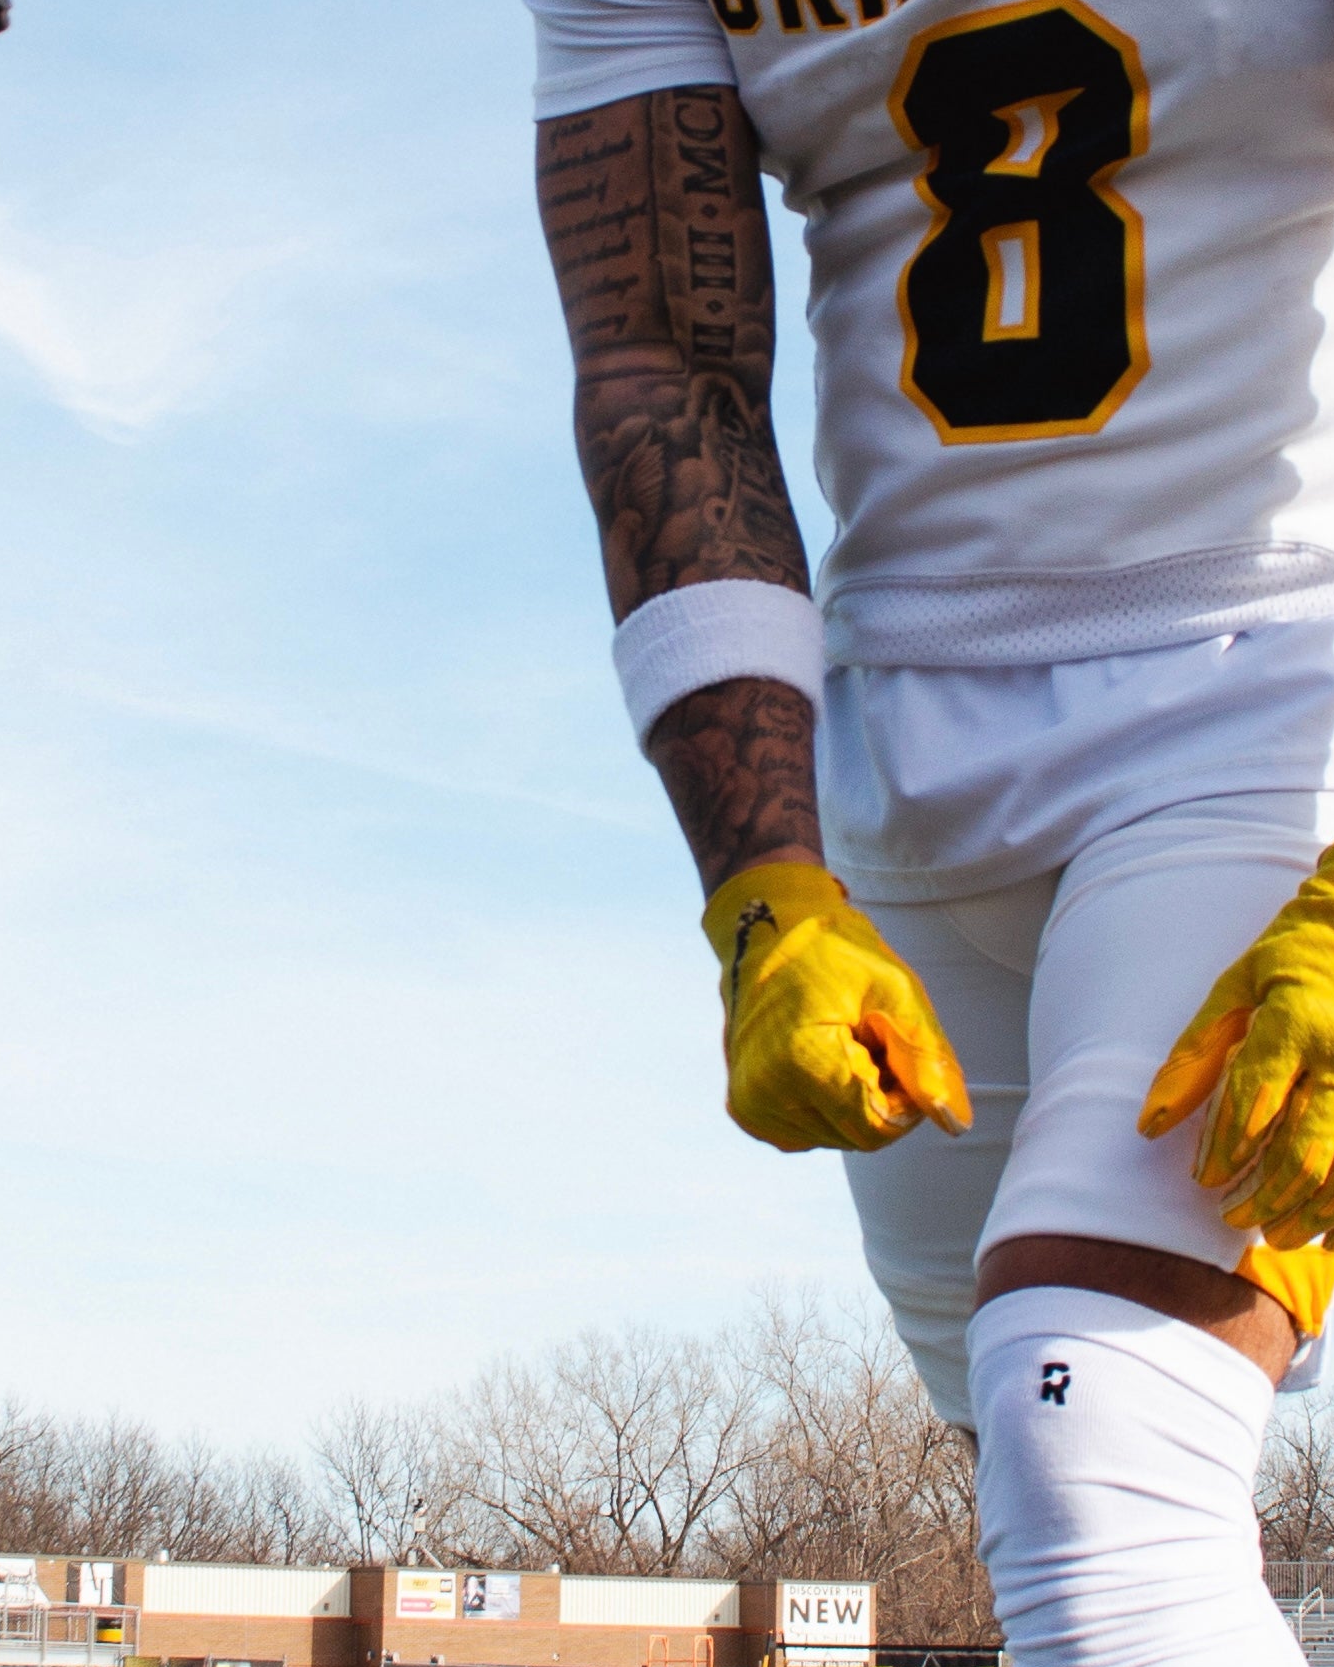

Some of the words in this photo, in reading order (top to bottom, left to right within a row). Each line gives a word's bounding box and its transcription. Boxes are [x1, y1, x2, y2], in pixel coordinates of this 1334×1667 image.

[789, 1586, 841, 1596] DISCOVER
[846, 1587, 864, 1597] THE
[789, 1598, 863, 1625] NEW
